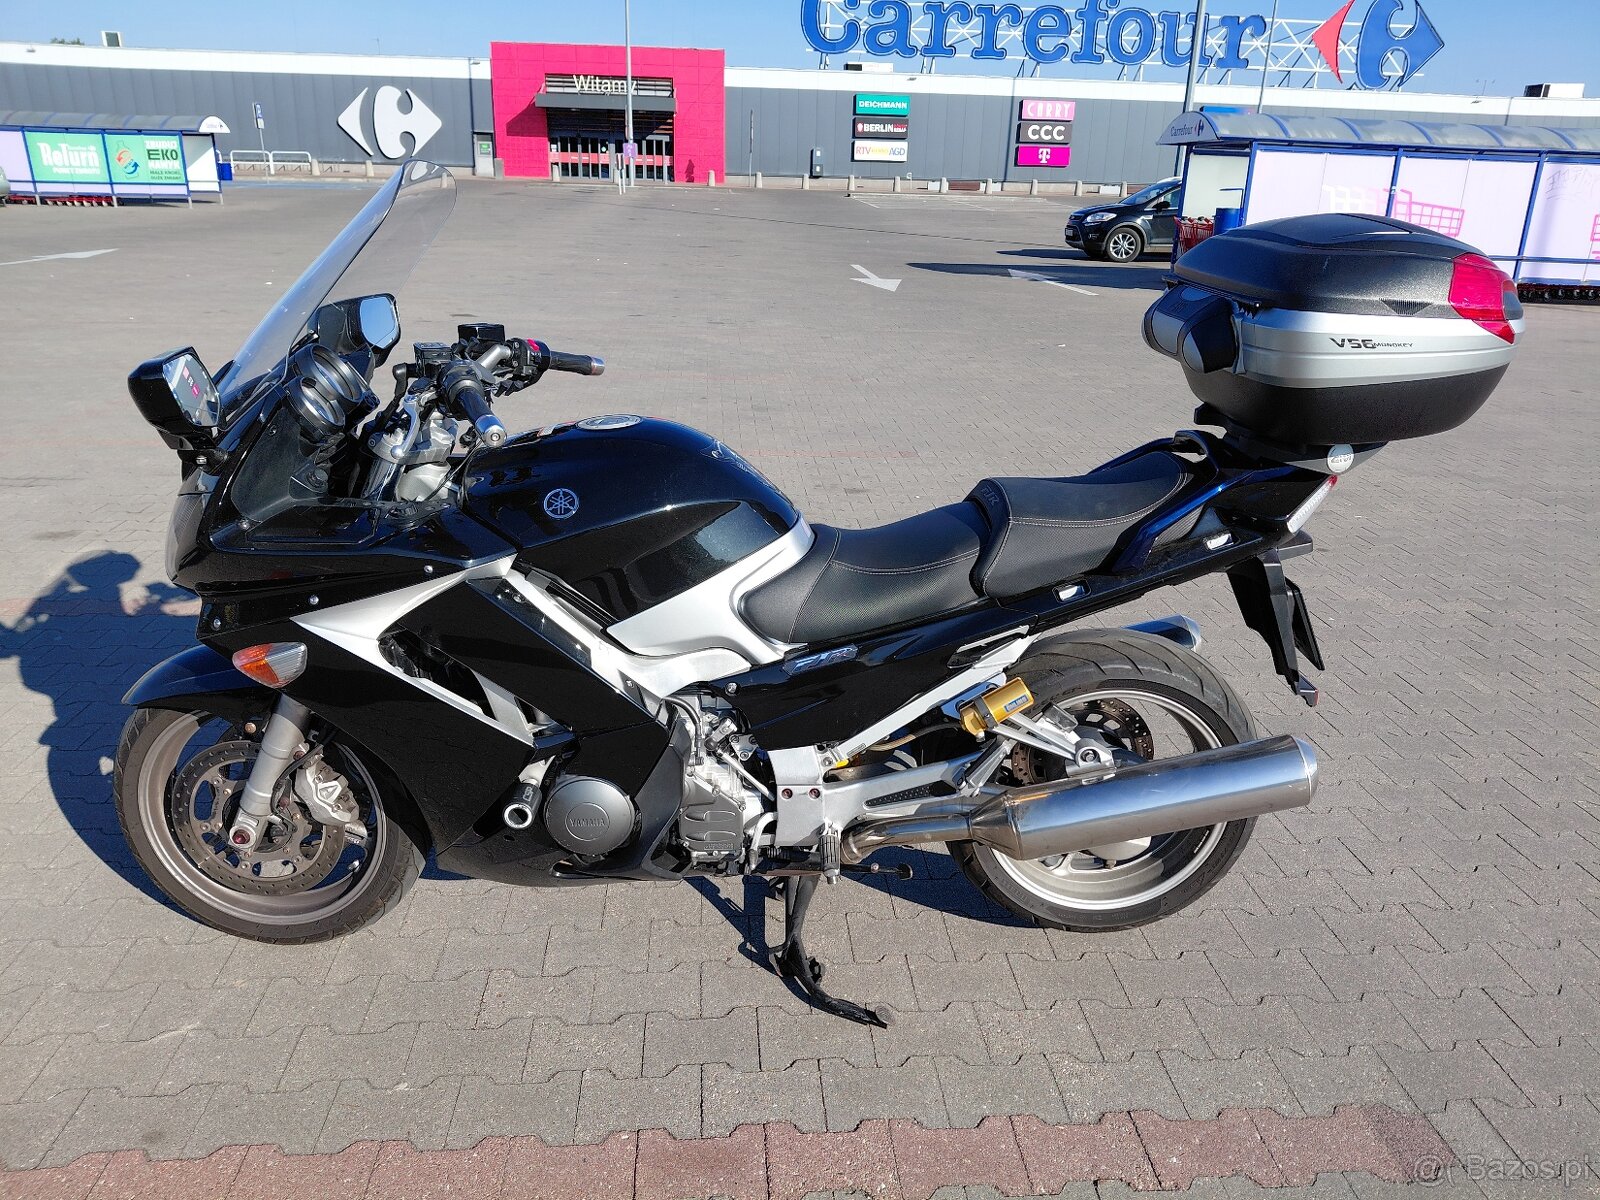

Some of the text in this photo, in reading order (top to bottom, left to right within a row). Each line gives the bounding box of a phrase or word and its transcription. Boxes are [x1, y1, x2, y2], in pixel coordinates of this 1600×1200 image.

[801, 0, 1267, 69] Carrefour
[858, 101, 907, 109] DEICHMANN
[863, 124, 894, 132] BERLIN
[1028, 124, 1065, 140] CCC
[1171, 124, 1193, 136] Carrefour
[146, 149, 178, 160] EKO
[856, 146, 871, 155] RTV
[889, 147, 905, 156] AGD
[1038, 148, 1050, 164] T
[1329, 338, 1376, 349] V56
[569, 818, 606, 828] YAMAHA
